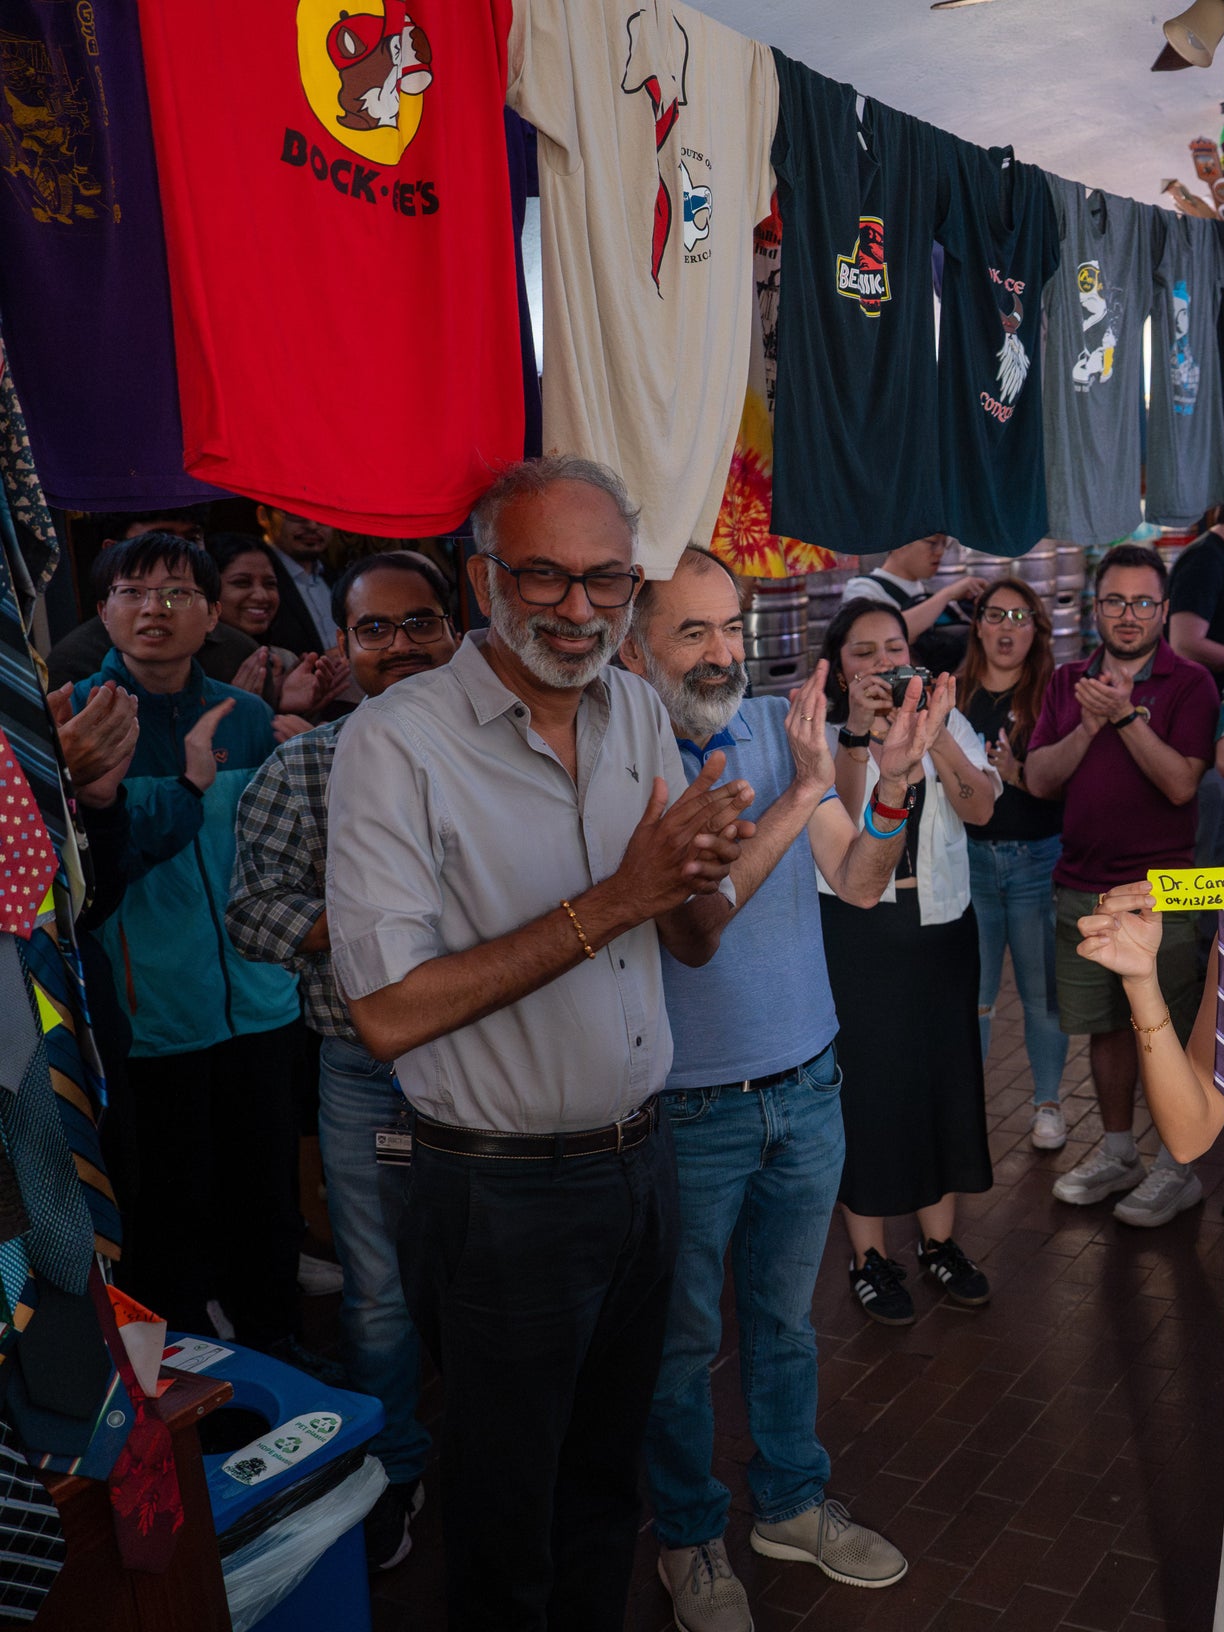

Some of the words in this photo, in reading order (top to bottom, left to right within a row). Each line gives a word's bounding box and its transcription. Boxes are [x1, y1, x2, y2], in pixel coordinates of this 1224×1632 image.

[1158, 875, 1189, 892] Dr.
[1165, 894, 1223, 906] 04/13/26
[295, 1421, 307, 1433] PET
[306, 1428, 328, 1443] plastic
[257, 1442, 275, 1457] HDPE
[272, 1453, 294, 1466] plastic
